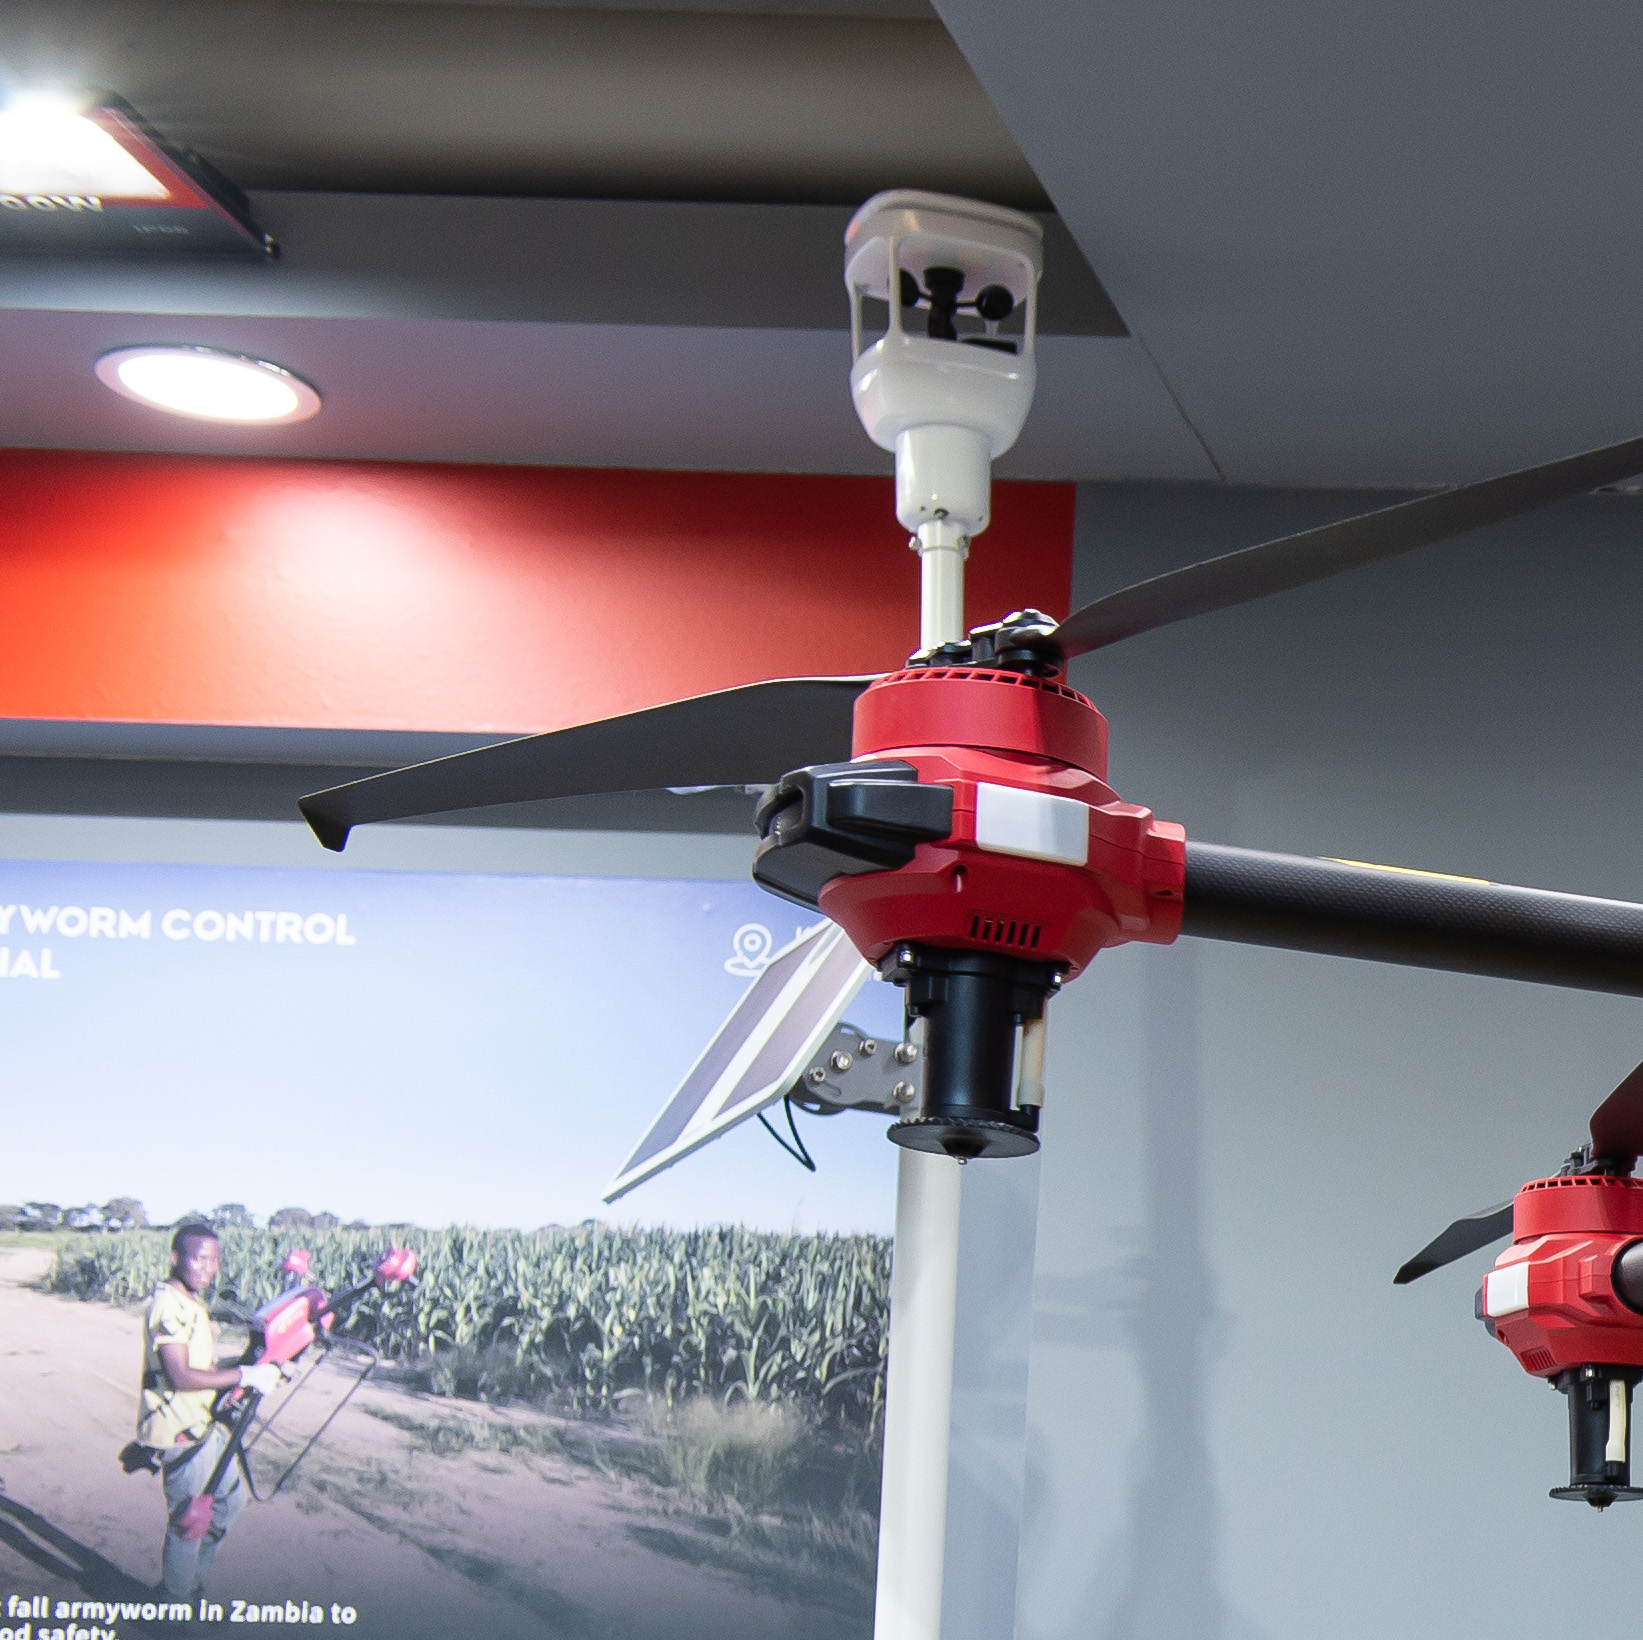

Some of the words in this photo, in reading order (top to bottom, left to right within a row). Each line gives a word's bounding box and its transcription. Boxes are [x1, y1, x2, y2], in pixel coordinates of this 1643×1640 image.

[161, 909, 357, 946] CONTROL
[7, 1594, 49, 1619] fall
[54, 1600, 192, 1625] armyworm
[199, 1599, 224, 1622] in
[230, 1600, 324, 1624] Zambia
[331, 1603, 357, 1625] to
